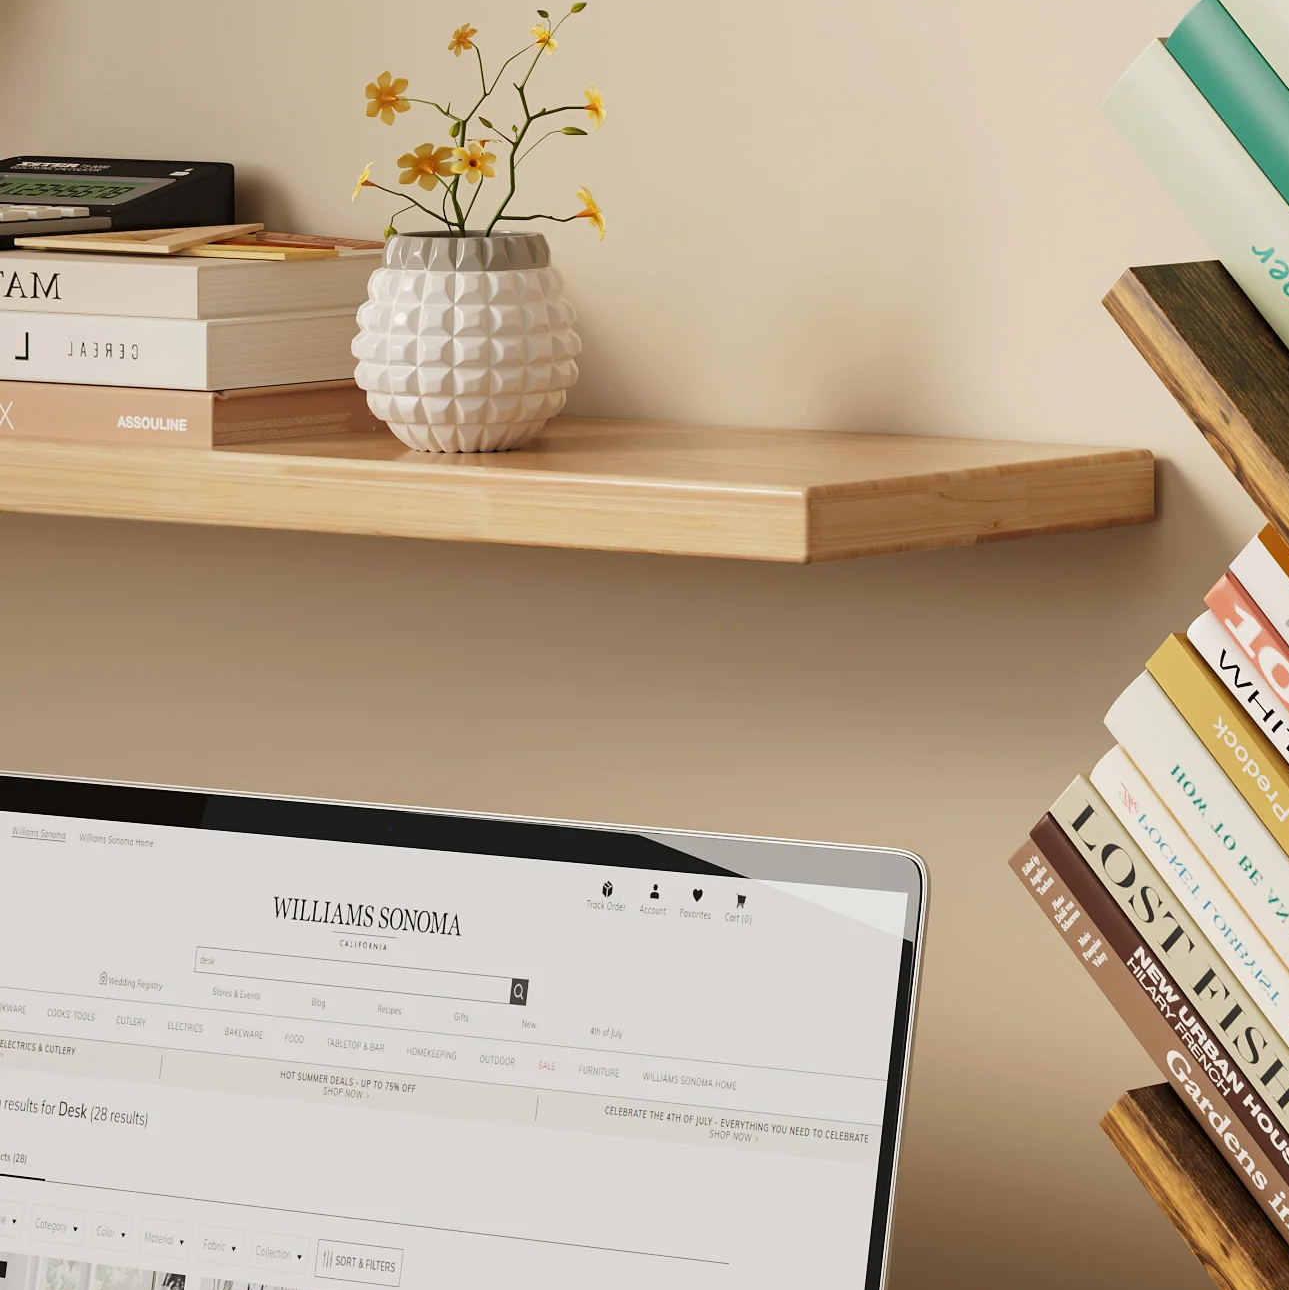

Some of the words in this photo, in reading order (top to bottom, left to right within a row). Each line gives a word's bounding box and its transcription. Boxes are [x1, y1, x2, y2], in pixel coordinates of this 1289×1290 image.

[117, 415, 188, 432] ASSOULINE
[1070, 803, 1195, 953] LOST
[273, 896, 374, 929] WILLIAMS
[378, 906, 462, 937] SONOMA
[339, 939, 388, 952] CALIFORNIA
[115, 1014, 147, 1028] CUTLERY
[166, 1020, 204, 1034] ELECTRICS
[224, 1026, 264, 1041] BAKEWARE
[1123, 955, 1177, 1023] HILARY
[1170, 1017, 1234, 1099] FRENCH
[1129, 943, 1185, 1012] NEW
[1172, 1002, 1247, 1096] URBAN
[280, 1069, 295, 1081] HOT
[296, 1071, 328, 1086] SUMMER
[329, 1074, 354, 1088] DEALS
[361, 1077, 371, 1089] UP
[372, 1078, 383, 1090] TO
[384, 1079, 401, 1092] 75%
[401, 1081, 417, 1094] OFF
[3, 1096, 39, 1116] results
[41, 1099, 57, 1116] for
[58, 1101, 88, 1120] Desk
[90, 1104, 108, 1124] (28
[109, 1107, 149, 1128] results)
[604, 1105, 646, 1122] CELEBRATE
[648, 1108, 664, 1122] THE
[666, 1110, 682, 1124] 4TH
[683, 1112, 694, 1124] OF
[695, 1113, 713, 1127] JULY
[720, 1117, 769, 1134] EVERYTHING
[770, 1122, 788, 1135] YOU
[789, 1123, 811, 1137] NEED
[812, 1126, 823, 1138] TO
[824, 1127, 870, 1145] CELEBRATE
[1159, 1047, 1272, 1194] Gardens
[335, 1254, 357, 1269] SORT
[364, 1258, 396, 1274] FILTERS
